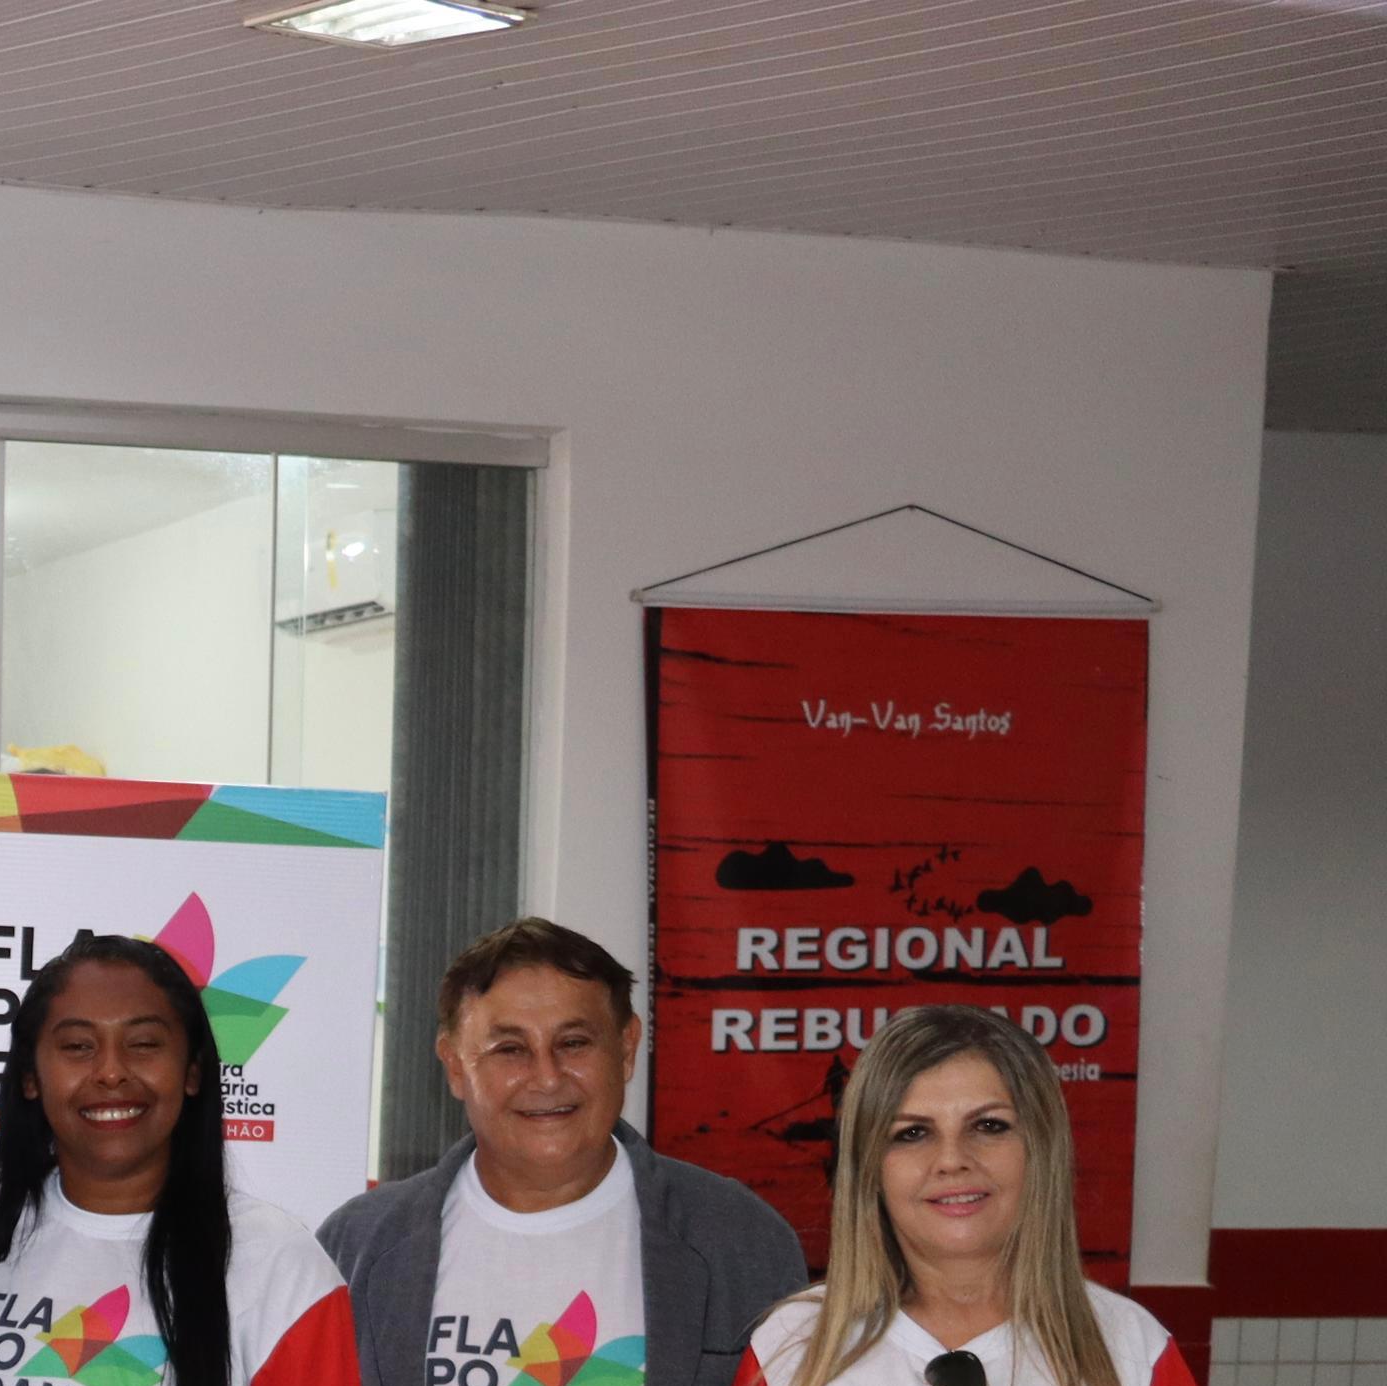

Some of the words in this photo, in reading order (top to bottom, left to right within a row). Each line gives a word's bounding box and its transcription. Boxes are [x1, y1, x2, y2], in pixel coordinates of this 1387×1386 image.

[928, 703, 1011, 741] Santos
[737, 926, 1064, 971] REGIONAL
[711, 1004, 1107, 1052] REBUDO
[220, 1078, 258, 1097] ária
[226, 1122, 265, 1138] HÃO
[428, 1315, 521, 1358] FLA
